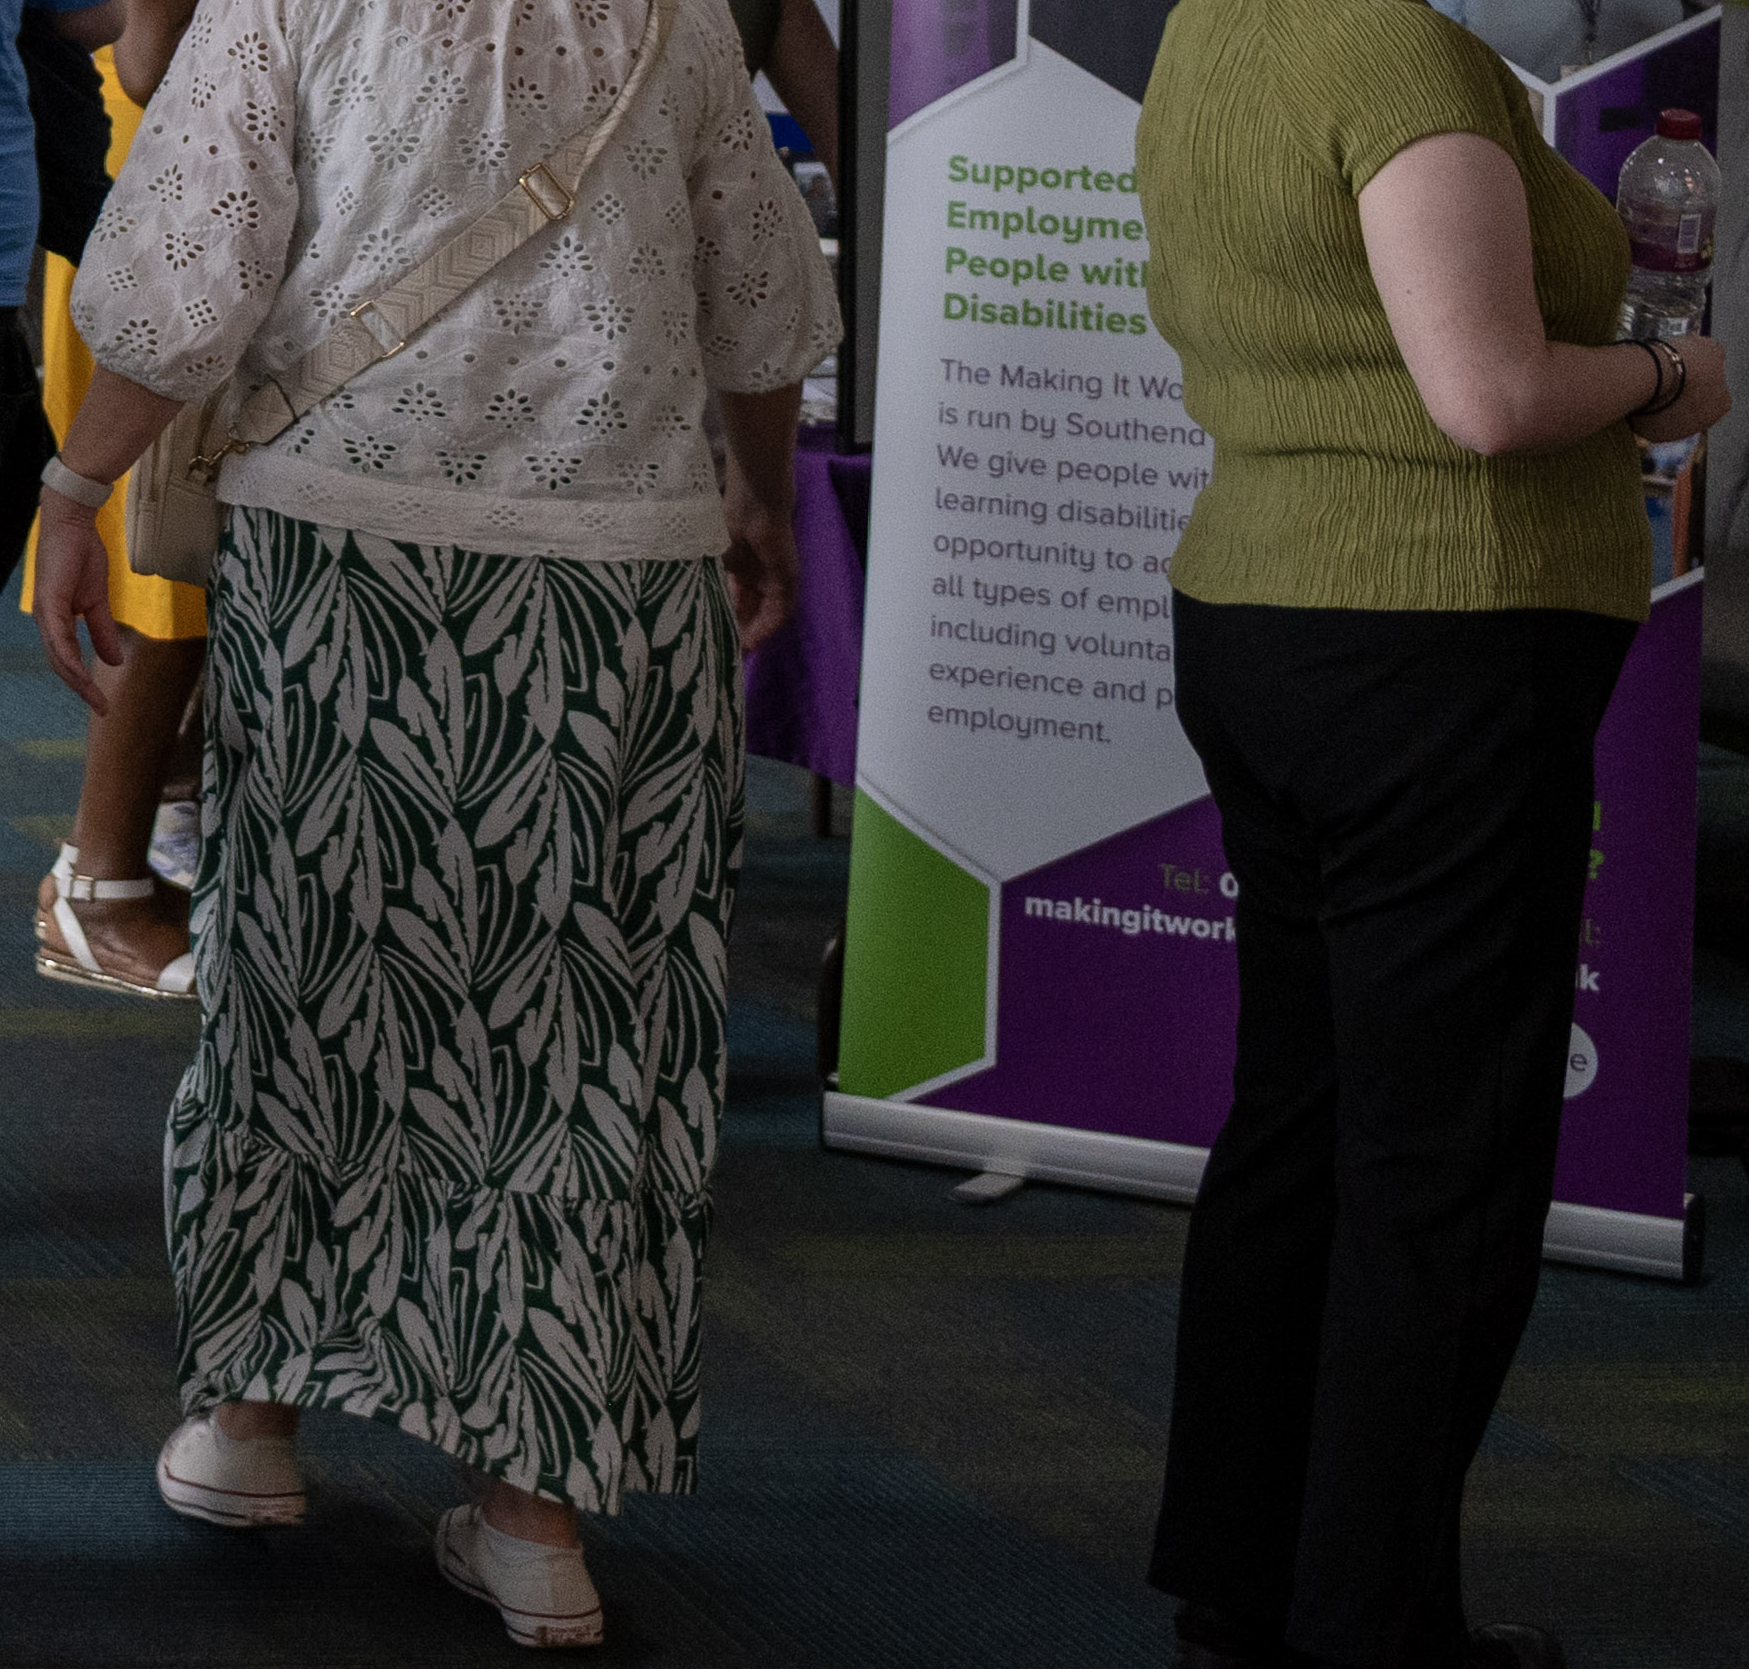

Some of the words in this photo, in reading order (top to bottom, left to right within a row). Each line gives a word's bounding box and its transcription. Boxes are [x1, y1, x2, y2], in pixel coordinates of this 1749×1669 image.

[948, 154, 1138, 194] Supported
[947, 199, 1144, 244] Employme
[945, 246, 1069, 287] People
[943, 292, 1148, 335] Disabilities
[940, 357, 991, 385] The
[1000, 363, 1103, 400] Making
[1112, 372, 1130, 397] It
[1139, 375, 1183, 401] Wo
[938, 401, 958, 425] is
[967, 410, 1011, 431] run
[1021, 408, 1056, 440] by
[936, 443, 979, 470] We
[987, 449, 1048, 478] give
[1056, 458, 1159, 488] people
[1168, 468, 1210, 489] wit
[935, 486, 1049, 526] learning
[1057, 499, 1193, 532] disabilitie
[933, 534, 1095, 573] opportunity
[1105, 547, 1134, 572] to
[932, 573, 965, 599] all
[973, 577, 1052, 607] types
[1060, 586, 1091, 610] of
[1097, 593, 1170, 621] empl
[930, 614, 1056, 656] including
[1064, 632, 1172, 663] volunta
[928, 661, 1084, 696] experience
[1092, 679, 1146, 705] and
[1155, 686, 1174, 710] p
[927, 704, 1112, 744] employment.
[1159, 863, 1210, 894] Tel:
[1219, 871, 1240, 898] 0
[1024, 895, 1237, 942] makingitwork
